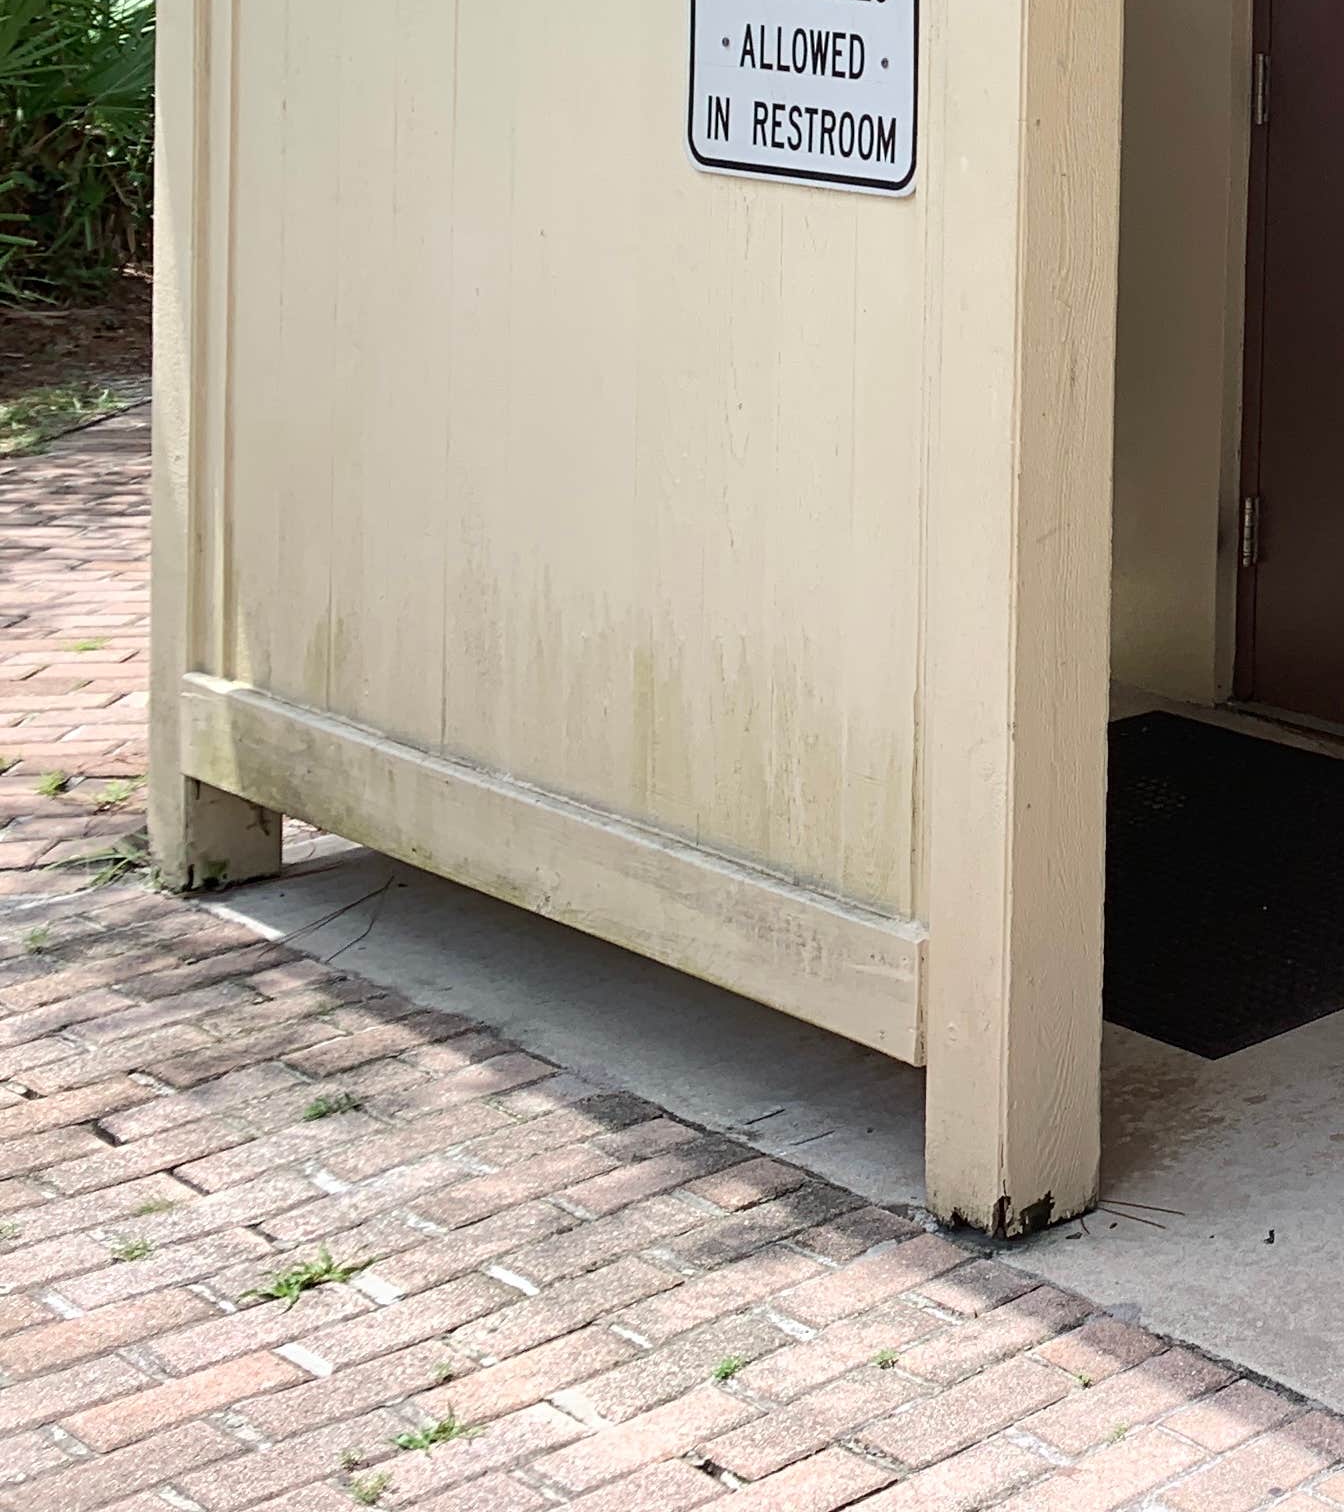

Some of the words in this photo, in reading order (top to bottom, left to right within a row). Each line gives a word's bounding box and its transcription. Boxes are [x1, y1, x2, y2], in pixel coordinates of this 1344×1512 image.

[739, 23, 865, 80] ALLOWED
[707, 95, 730, 141] IN
[753, 100, 896, 164] RESTROOM
